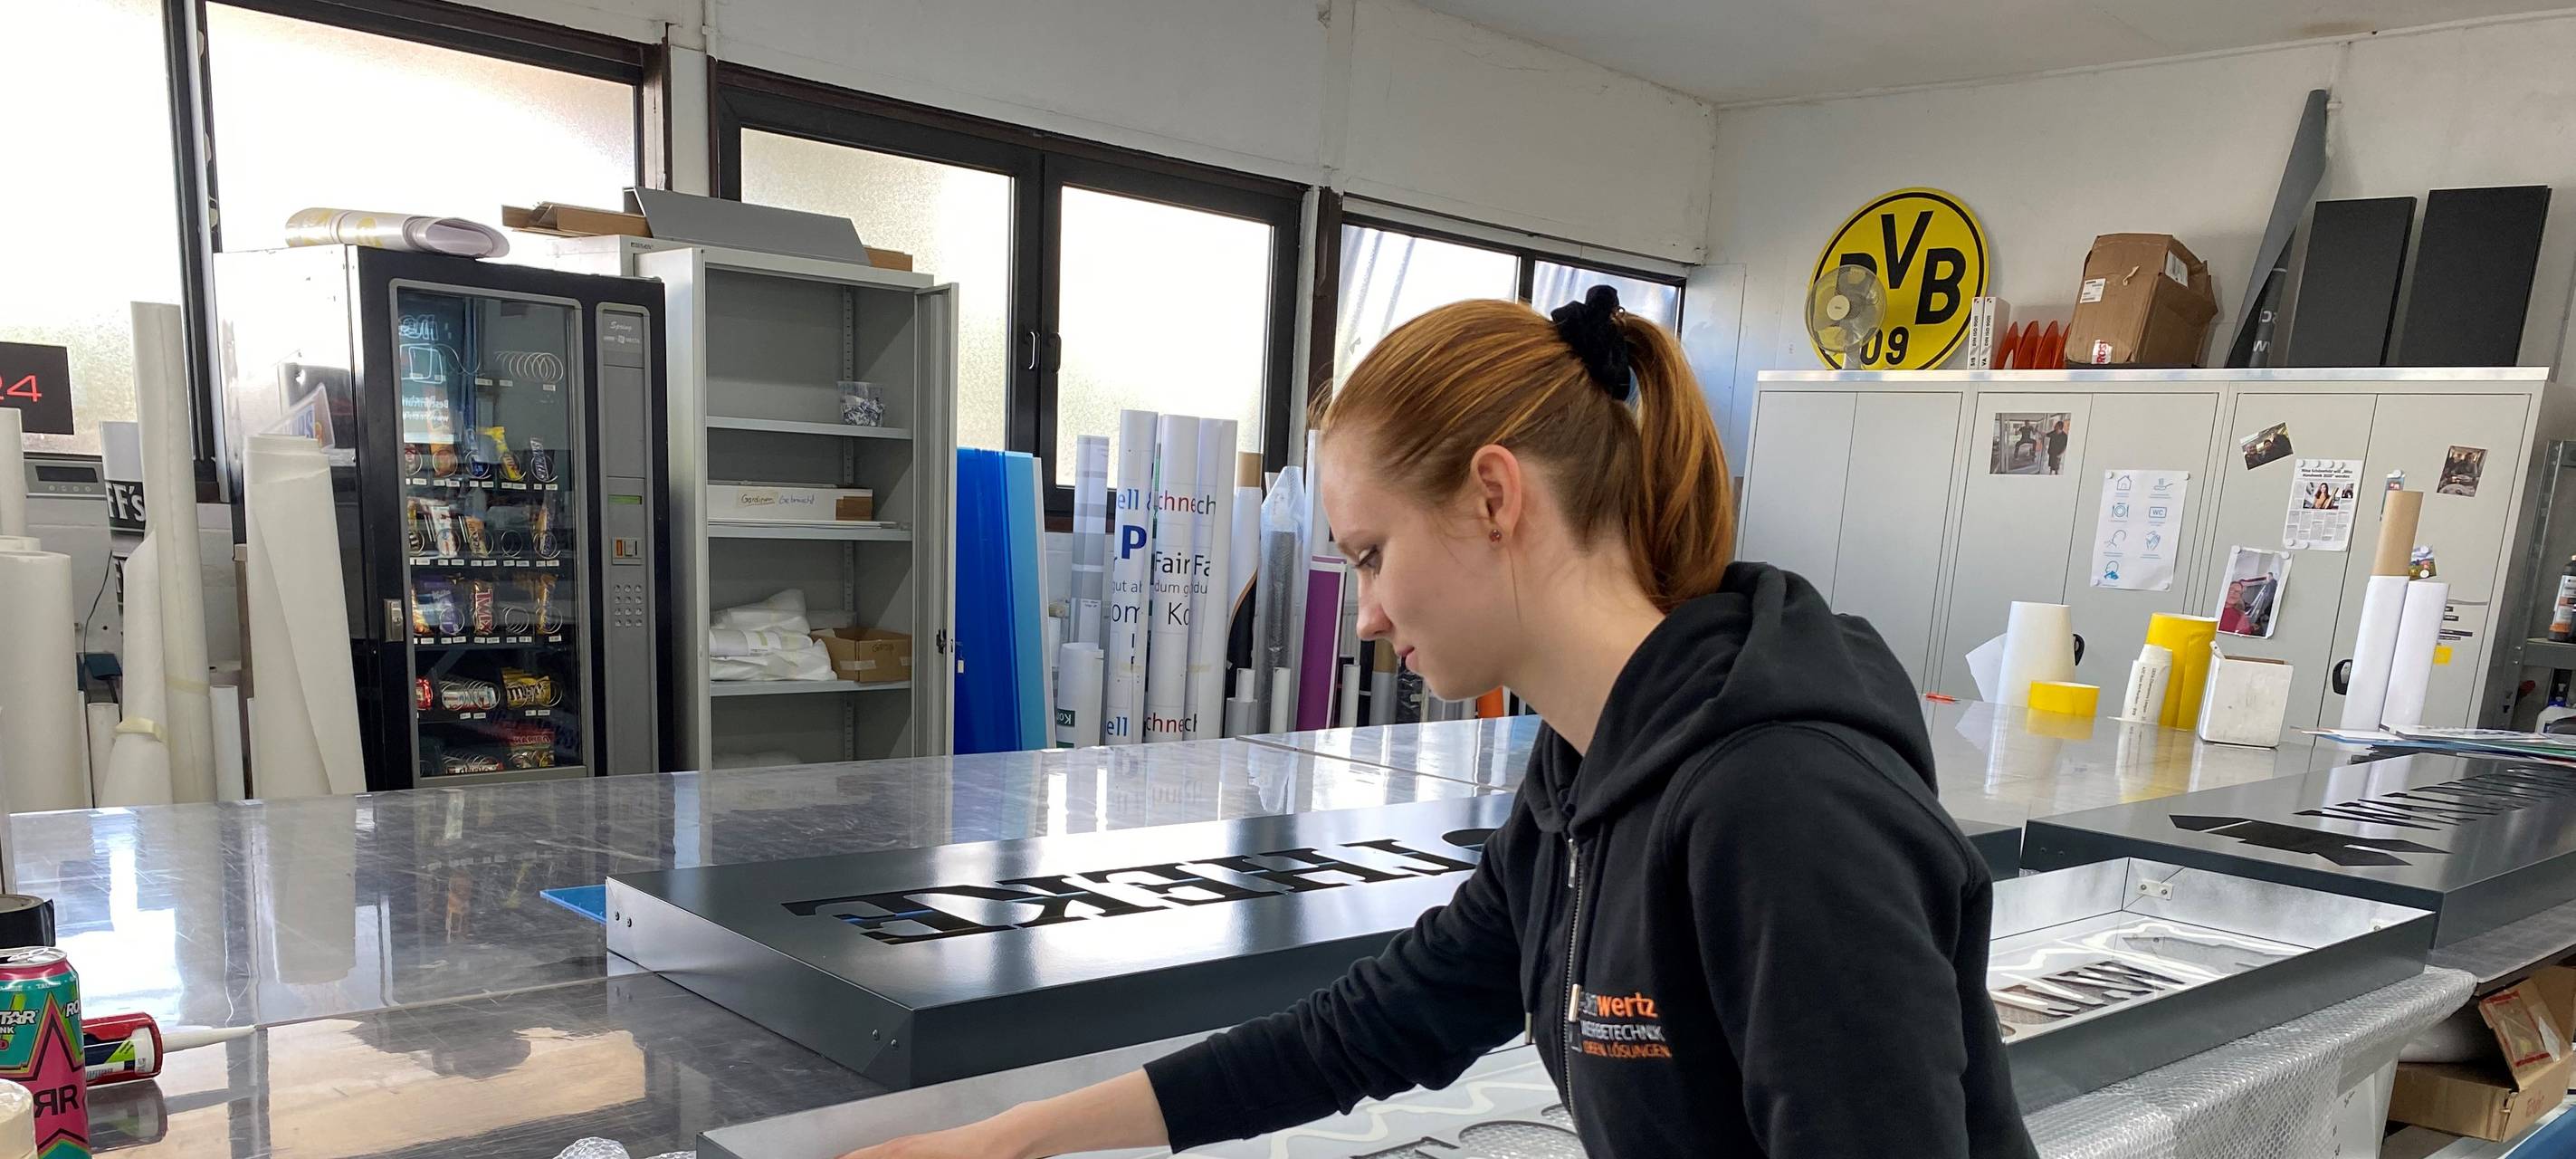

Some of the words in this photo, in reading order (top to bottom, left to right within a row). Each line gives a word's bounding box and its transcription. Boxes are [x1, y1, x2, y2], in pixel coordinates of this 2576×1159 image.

[1861, 326, 1909, 366] 09
[0, 375, 42, 402] 4
[1121, 524, 1147, 560] P
